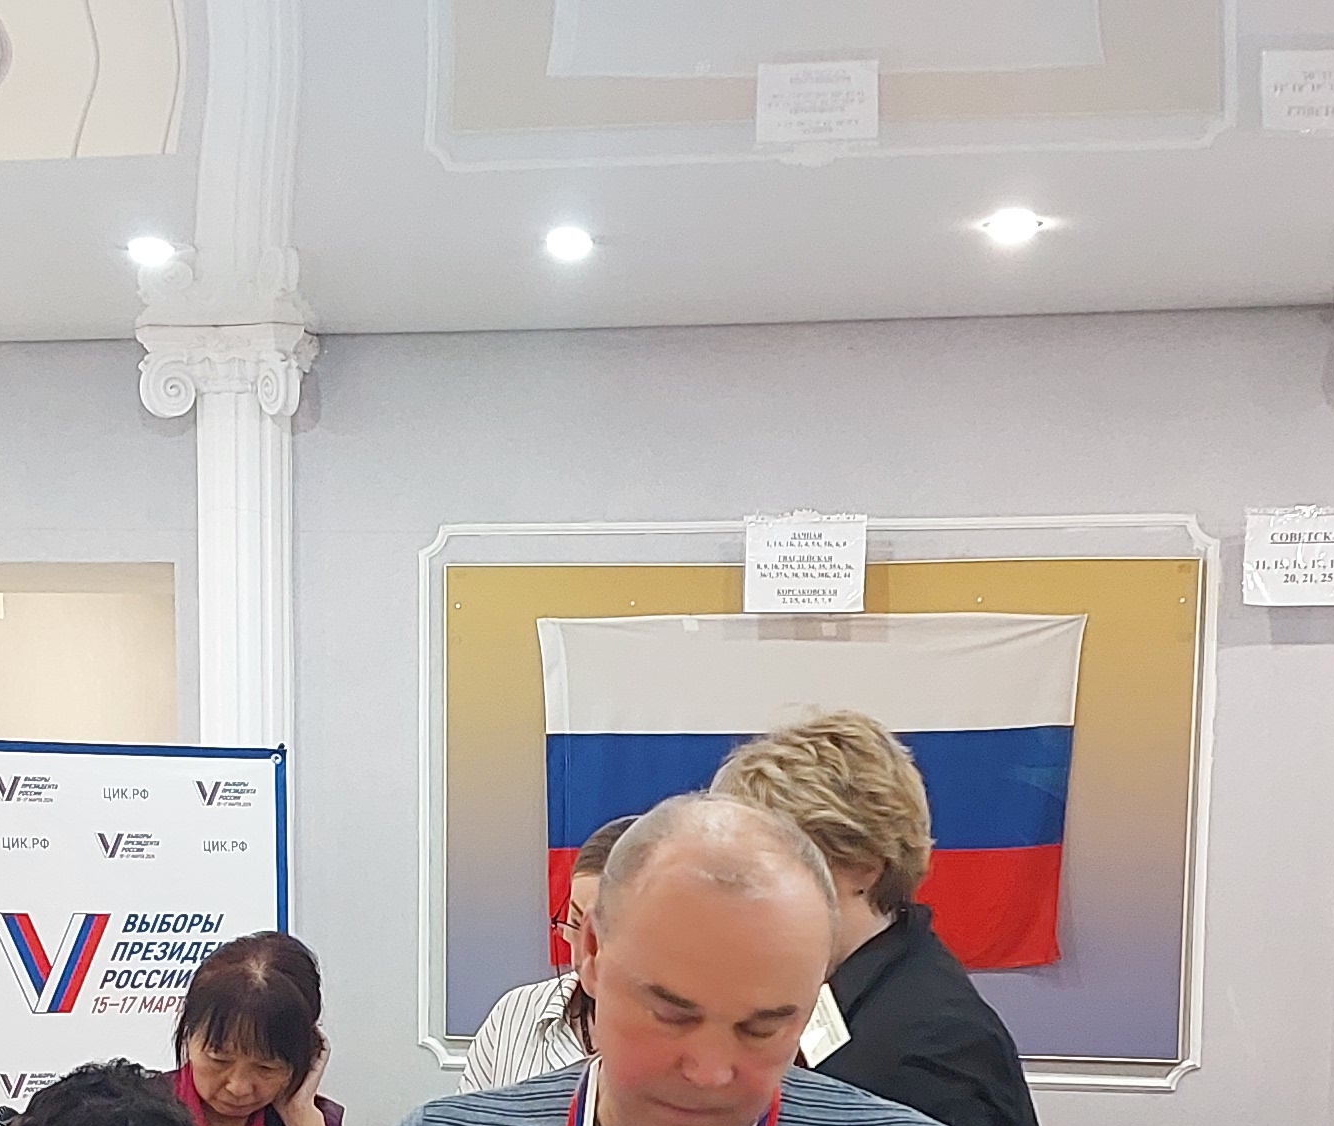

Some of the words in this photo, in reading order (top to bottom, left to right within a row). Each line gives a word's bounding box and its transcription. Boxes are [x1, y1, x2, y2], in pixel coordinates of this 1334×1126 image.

[103, 788, 149, 801] ЦИК.РФ
[2, 837, 50, 851] ЦИК.РФ
[203, 841, 248, 854] ЦИК.РФ
[122, 914, 224, 933] ВЫБОРЫ
[111, 942, 223, 964] ПРЕЗИДЕ
[99, 970, 193, 989] РОССИИ
[138, 996, 186, 1014] МАРТ
